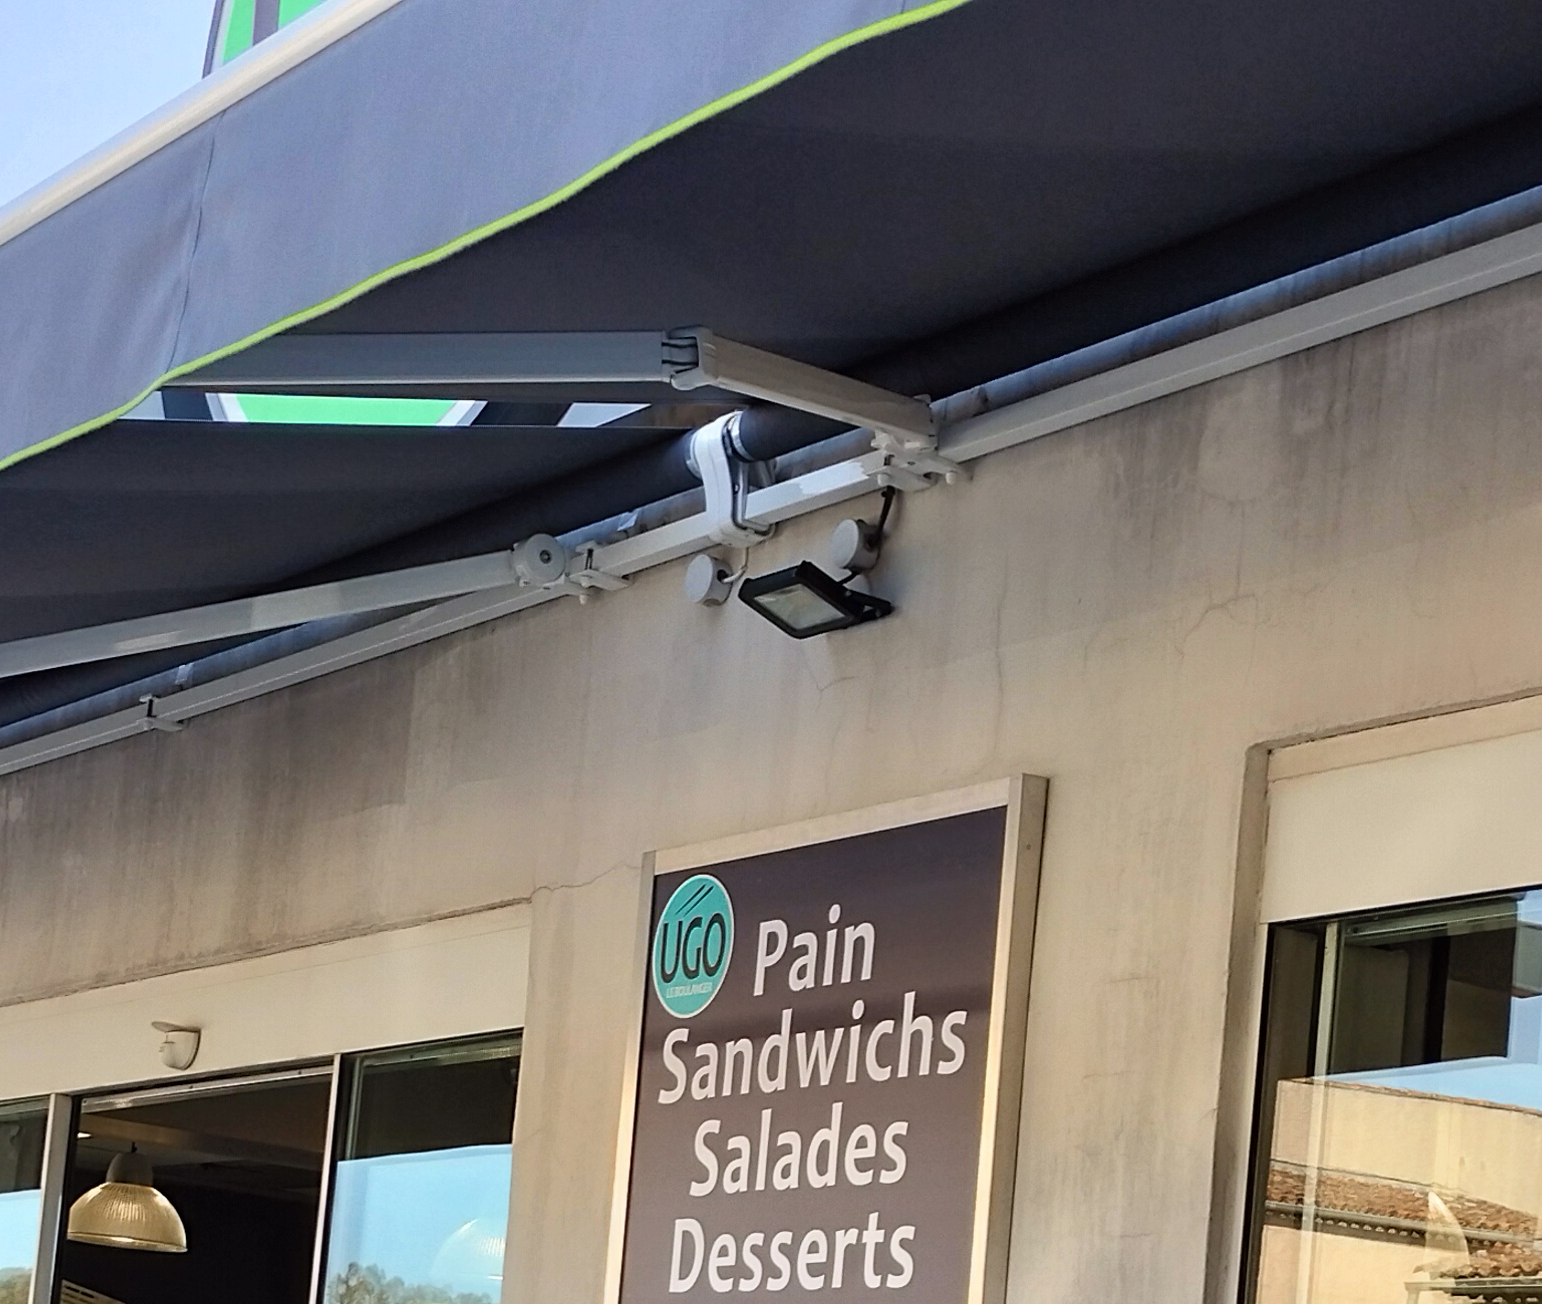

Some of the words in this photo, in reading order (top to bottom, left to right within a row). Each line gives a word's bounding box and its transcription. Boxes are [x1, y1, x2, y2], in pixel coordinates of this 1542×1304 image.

[660, 912, 726, 984] UGO
[752, 904, 875, 998] Pain
[658, 991, 967, 1105] Sandwichs
[689, 1102, 909, 1197] Salades
[668, 1211, 916, 1294] Desserts
